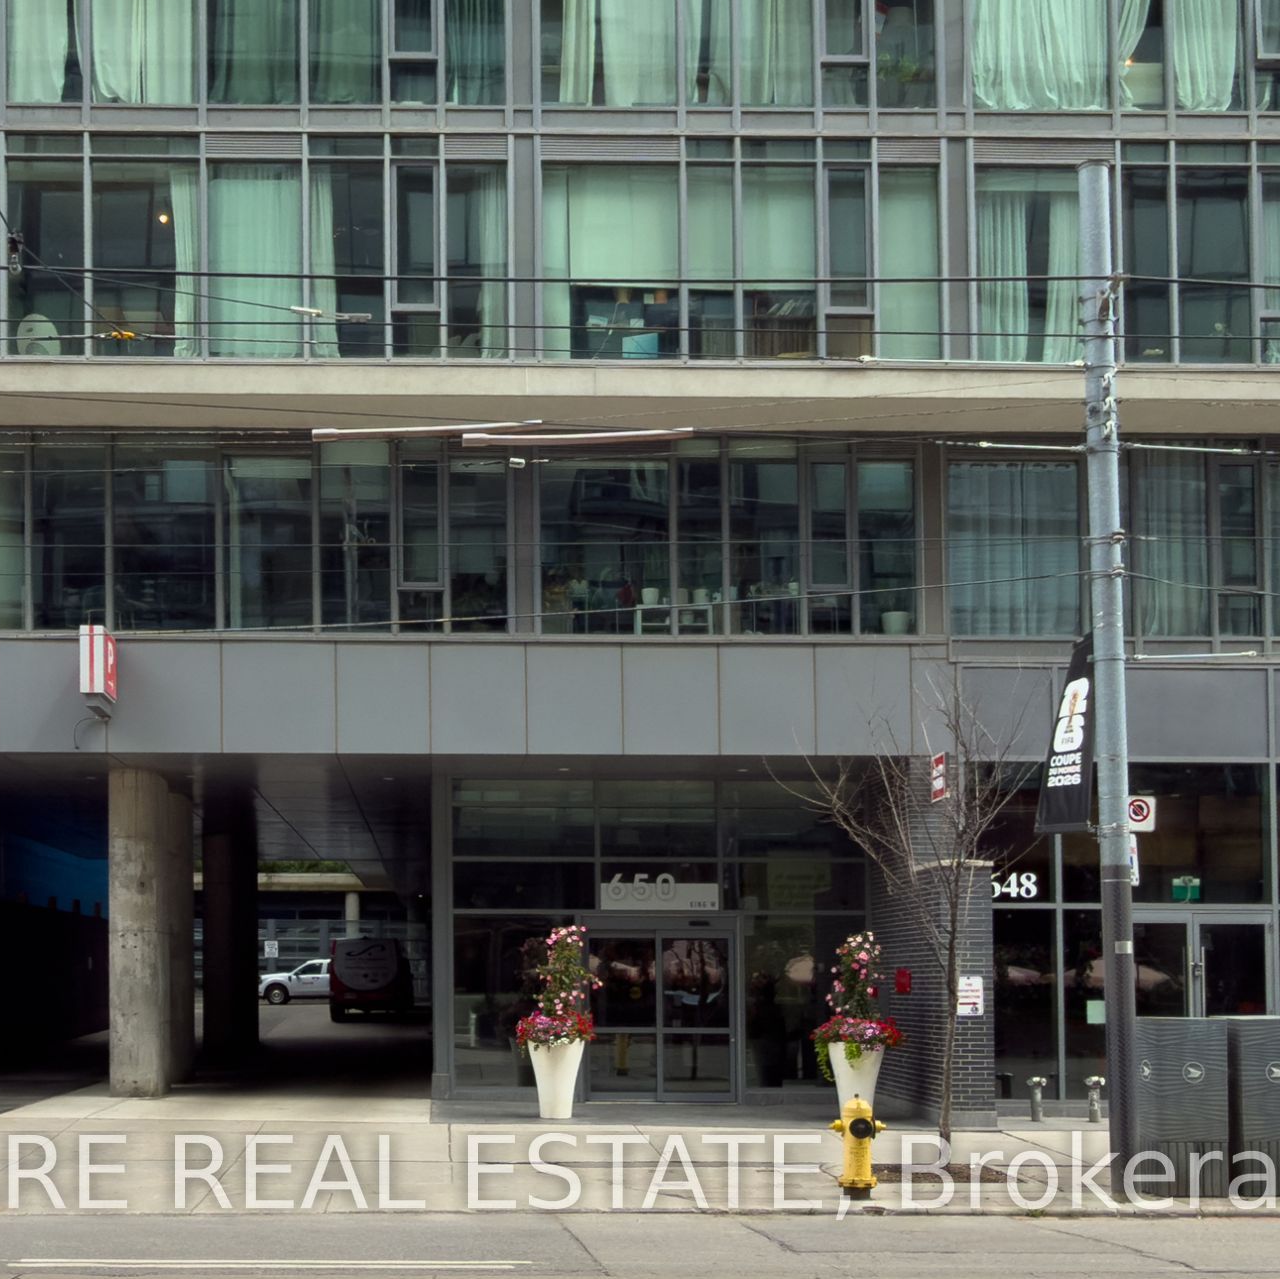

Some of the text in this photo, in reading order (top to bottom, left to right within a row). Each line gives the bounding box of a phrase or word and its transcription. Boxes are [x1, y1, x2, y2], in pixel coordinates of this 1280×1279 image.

[107, 640, 114, 674] P
[1061, 736, 1075, 746] FIFA
[1050, 753, 1082, 767] COUPE
[1060, 764, 1082, 776] MONDE
[1047, 773, 1082, 788] 2026
[607, 872, 677, 901] 650
